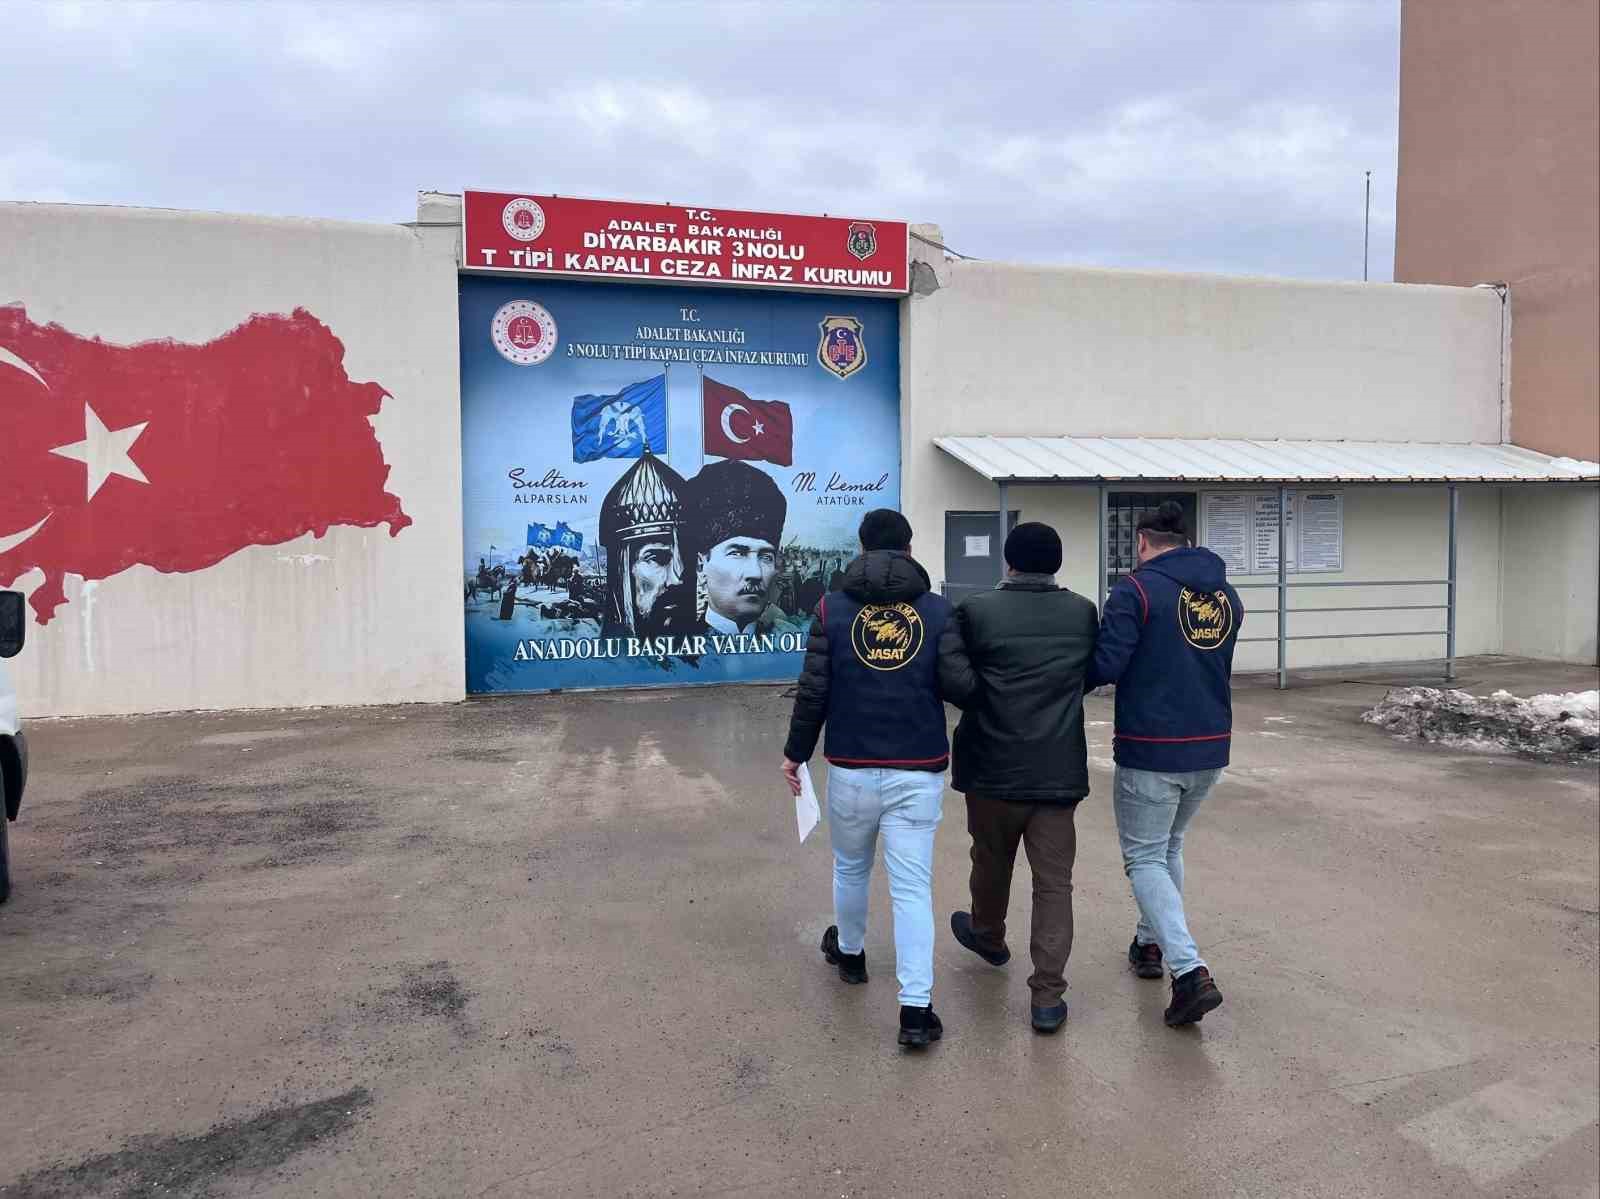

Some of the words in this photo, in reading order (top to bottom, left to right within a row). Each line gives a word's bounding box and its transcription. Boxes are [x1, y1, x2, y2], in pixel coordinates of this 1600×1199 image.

[686, 209, 717, 221] T.C.
[608, 219, 677, 234] ADALET
[688, 224, 782, 240] BAKANLIĞI
[583, 229, 722, 256] DİYARBAKIR
[481, 248, 497, 265] T
[509, 246, 553, 268] TİPİ
[565, 253, 650, 273] KAPALI
[660, 258, 721, 277] CEZA
[732, 258, 793, 280] İNFAZ
[804, 266, 892, 286] KURUMU
[680, 308, 700, 322] T.C.
[636, 326, 681, 341] ADALET
[684, 328, 745, 344] BAKANLIĞI
[567, 344, 574, 357] 3
[576, 344, 610, 359] NOLU
[612, 345, 621, 359] T
[622, 343, 646, 360] TİPİ
[649, 347, 690, 361] KAPALI
[693, 348, 722, 363] CEZA
[725, 347, 758, 365] İNFAZ
[760, 351, 809, 366] KURUMU
[508, 467, 589, 489] Sultan
[791, 471, 817, 493] M.
[824, 471, 889, 493] Kemal
[514, 494, 588, 504] ALPARSLAN
[816, 495, 865, 506] ATATÜRK
[1190, 628, 1220, 640] JASAT
[513, 637, 621, 661] ANADOLU
[628, 635, 707, 661] BAŞLAR
[711, 633, 776, 654] VATAN
[867, 648, 906, 660] JASAT
